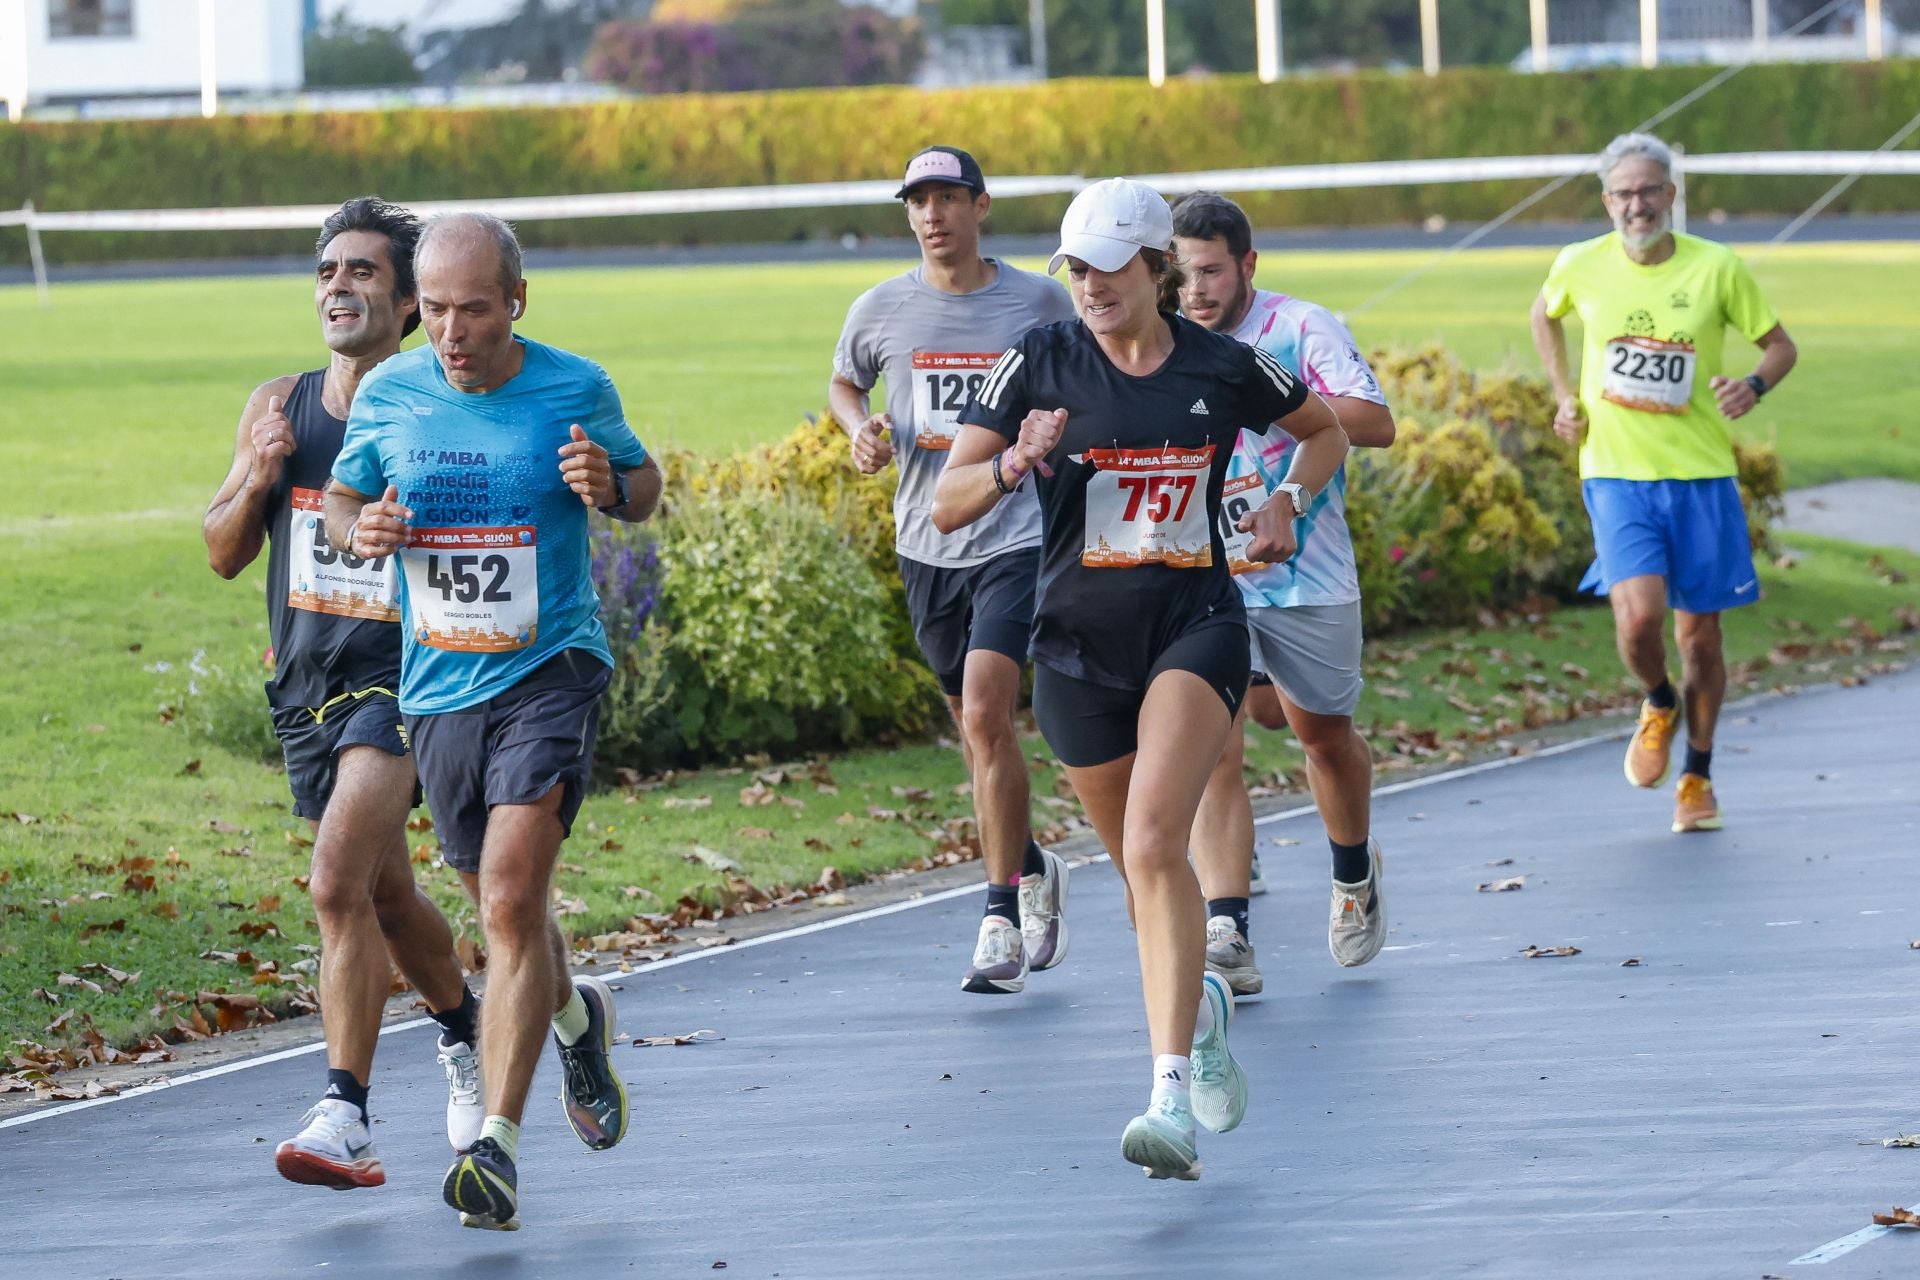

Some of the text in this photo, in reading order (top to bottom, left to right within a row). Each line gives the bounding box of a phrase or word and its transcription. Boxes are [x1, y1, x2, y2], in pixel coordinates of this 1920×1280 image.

[1612, 347, 1685, 383] 2230
[407, 449, 435, 464] 14ª
[437, 451, 488, 466] MBA
[1133, 457, 1160, 466] MBA
[425, 472, 489, 489] media
[407, 490, 489, 504] maratón
[1118, 475, 1197, 523] 757
[425, 505, 489, 524] GIJÓN
[434, 535, 461, 543] MBA
[484, 532, 513, 543] GIJÓN
[315, 573, 346, 583] ALFONSO
[427, 554, 512, 603] 452
[444, 611, 465, 619] SERGIO
